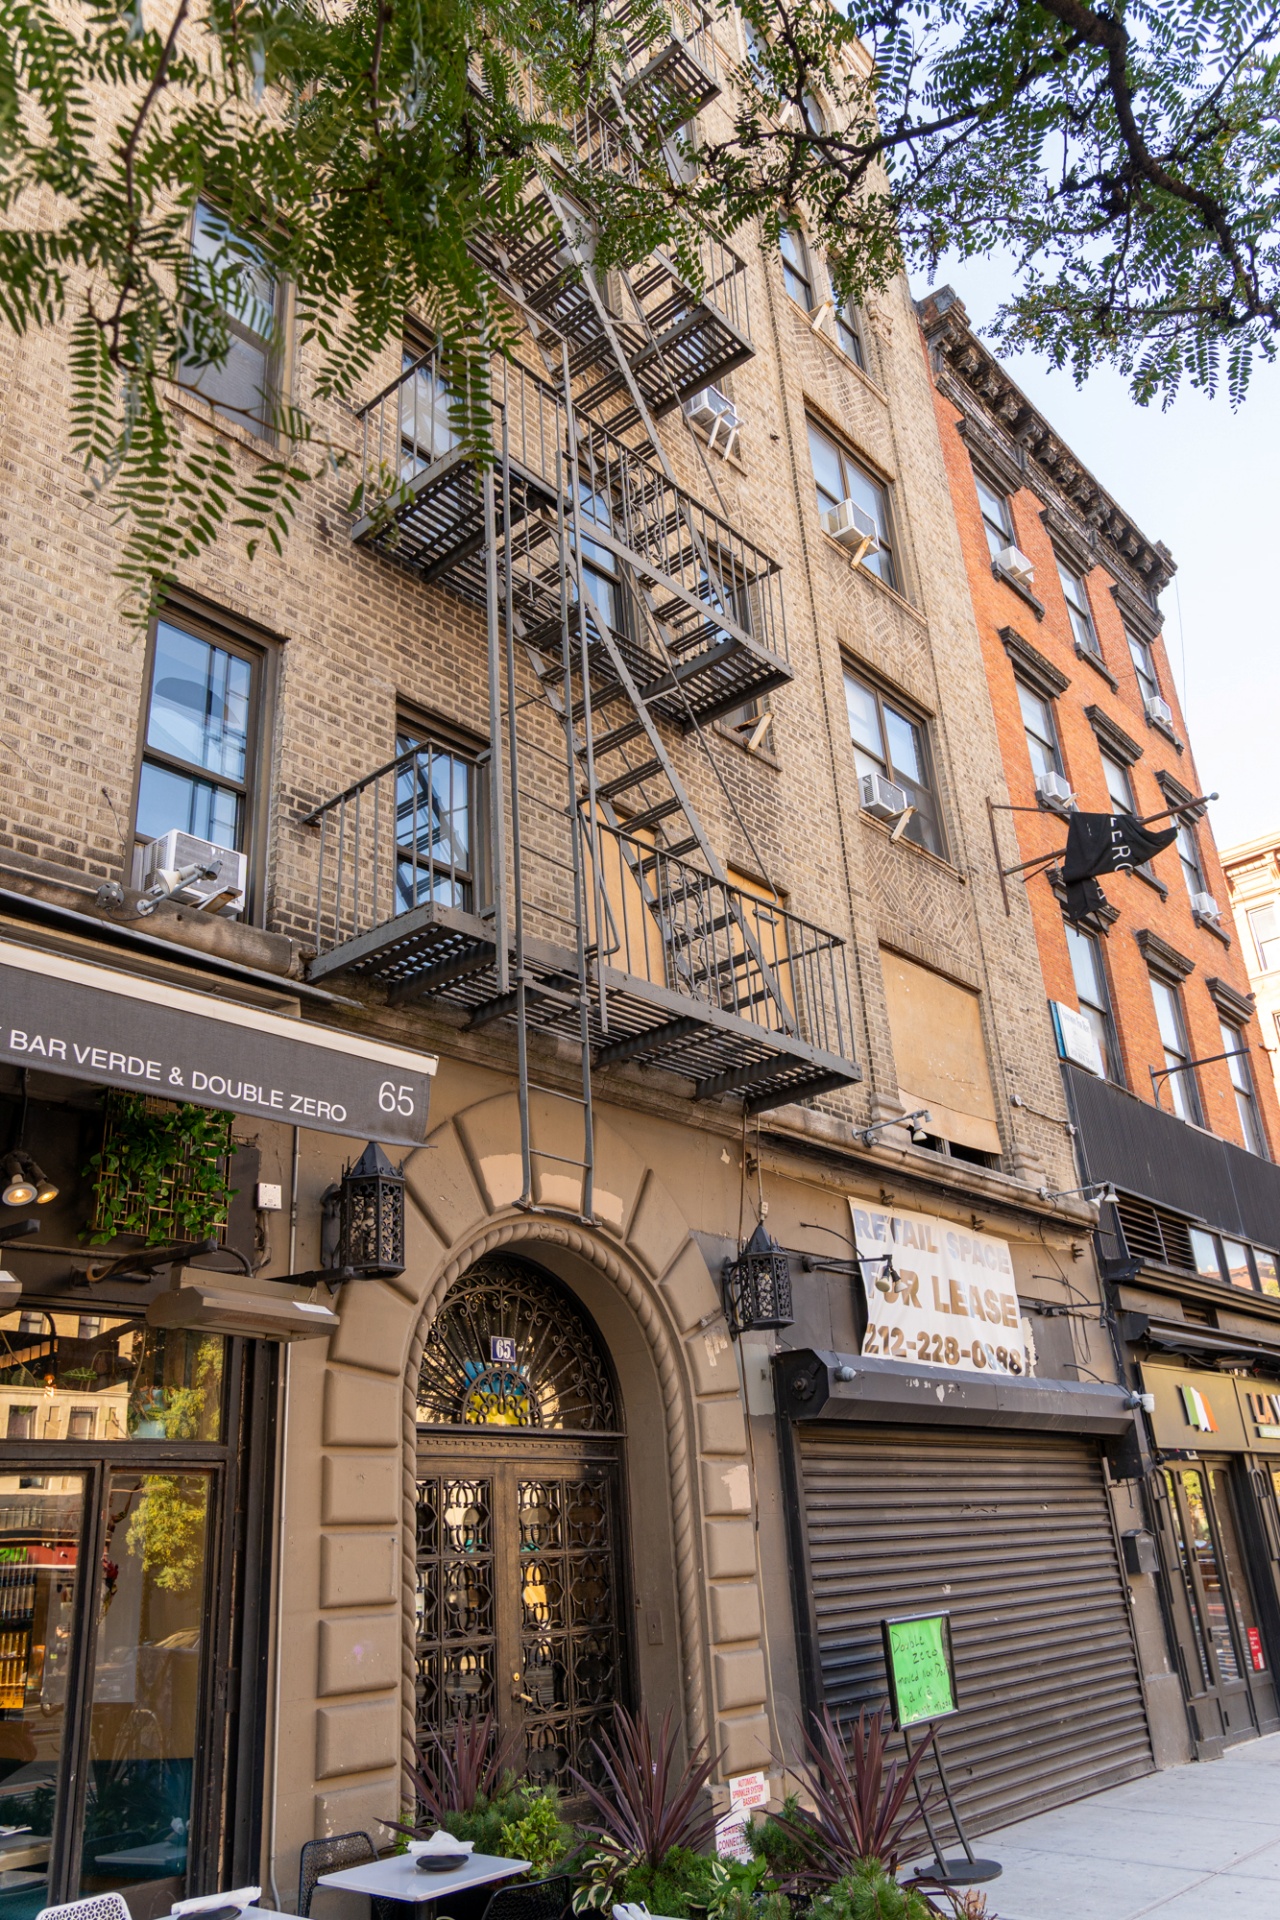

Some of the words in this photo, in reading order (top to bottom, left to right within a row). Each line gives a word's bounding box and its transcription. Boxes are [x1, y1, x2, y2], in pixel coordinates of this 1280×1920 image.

[10, 1030, 66, 1060] BAR
[73, 1043, 161, 1081] VERDE
[168, 1066, 184, 1086] &
[192, 1071, 283, 1109] DOUBLE
[289, 1094, 347, 1122] ZERO
[378, 1081, 414, 1116] 65
[853, 1208, 939, 1254] RETAIL
[946, 1231, 1010, 1275] SPACE
[932, 1275, 1018, 1329] LEASE
[496, 1340, 511, 1359] 65
[732, 1788, 750, 1800] SPRINKLER
[750, 1784, 764, 1795] SYSTEM
[738, 1776, 758, 1787] AUTOMATIC
[743, 1794, 761, 1807] BASEMENT
